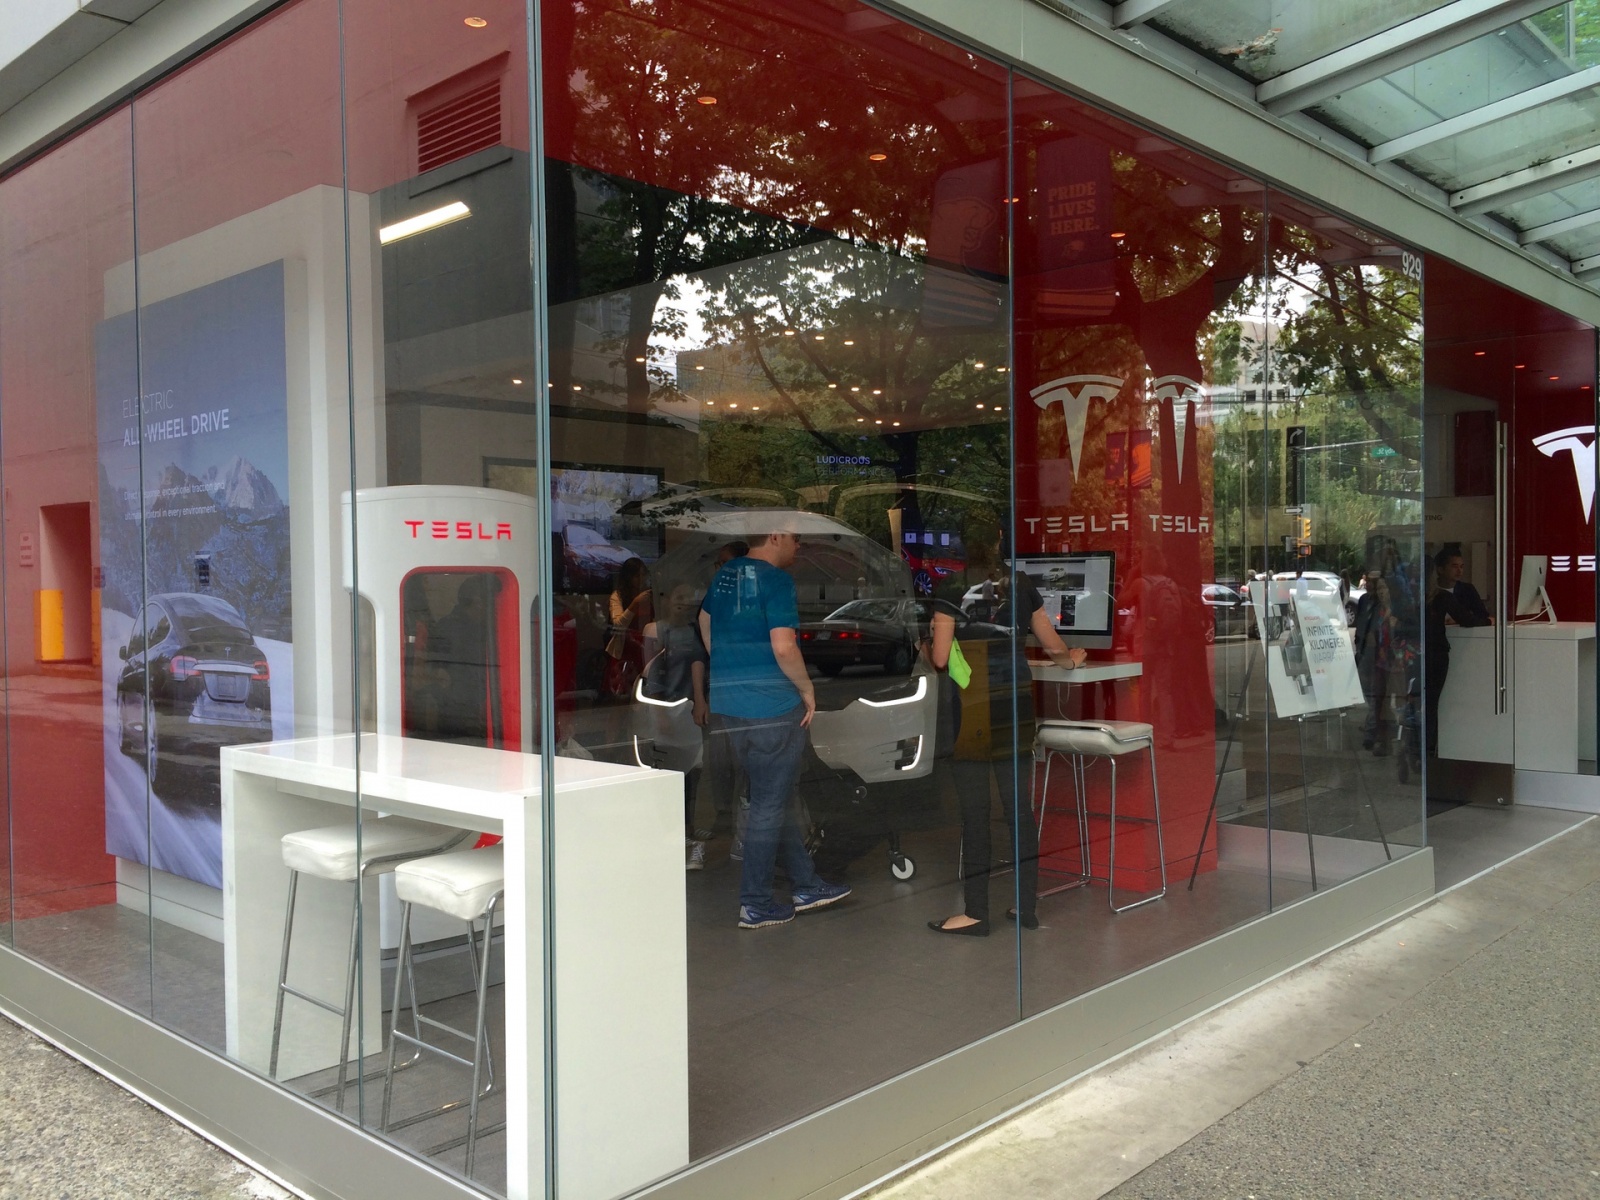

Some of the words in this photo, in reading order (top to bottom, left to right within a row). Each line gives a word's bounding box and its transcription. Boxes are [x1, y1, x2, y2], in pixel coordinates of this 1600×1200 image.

[1048, 181, 1096, 203] PRIDE
[1049, 199, 1096, 219] LIVES
[1050, 217, 1100, 236] HERE.
[1402, 251, 1422, 281] 929
[122, 389, 174, 419] ELECTRIC
[191, 408, 230, 435] DRIVE
[816, 455, 871, 465] LUDICROUS
[404, 520, 512, 540] TESLA
[1023, 513, 1129, 534] TESLA
[1148, 514, 1209, 533] TESLA
[1306, 624, 1335, 637] INFINITE
[1308, 637, 1346, 651] KILOMETER
